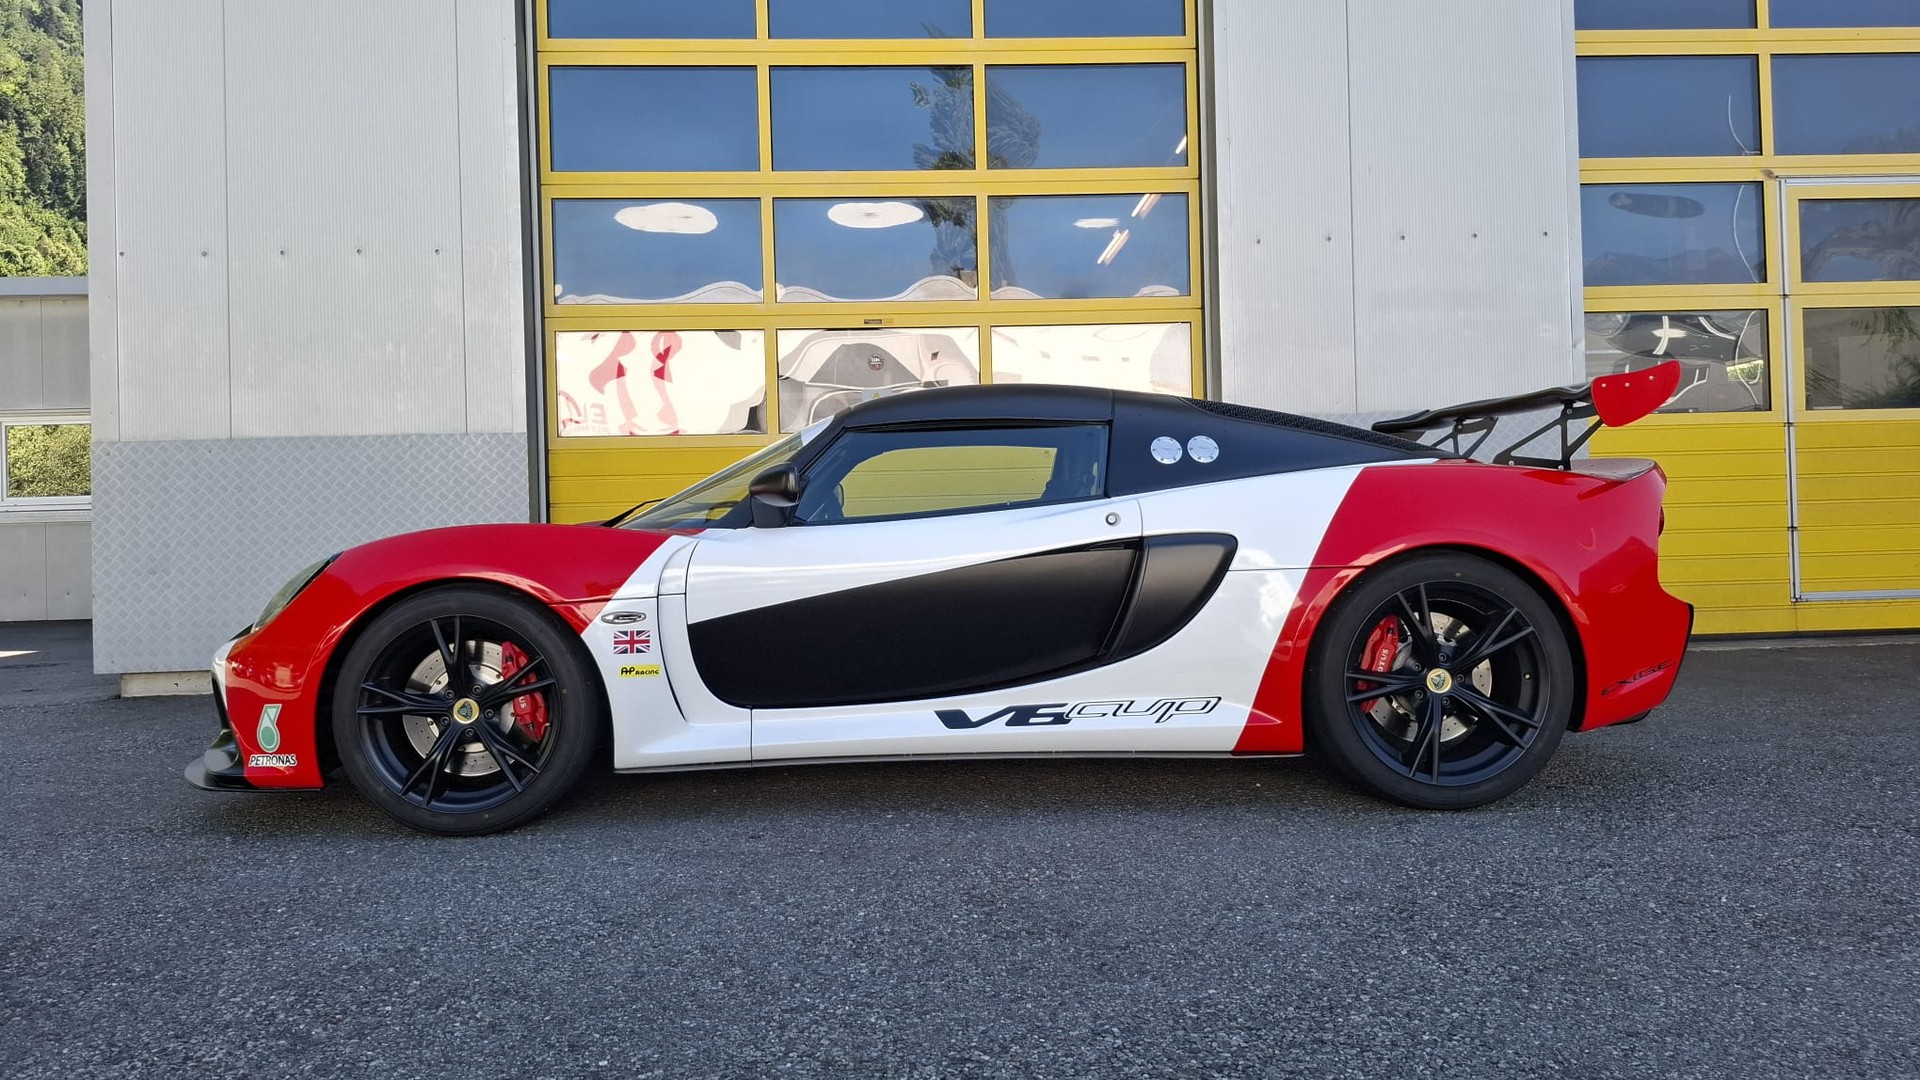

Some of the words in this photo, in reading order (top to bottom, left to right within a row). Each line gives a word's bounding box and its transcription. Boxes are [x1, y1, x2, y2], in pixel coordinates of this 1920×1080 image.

[1377, 648, 1389, 672] OTUS
[620, 666, 636, 676] AP
[249, 755, 297, 766] PETRONAS
